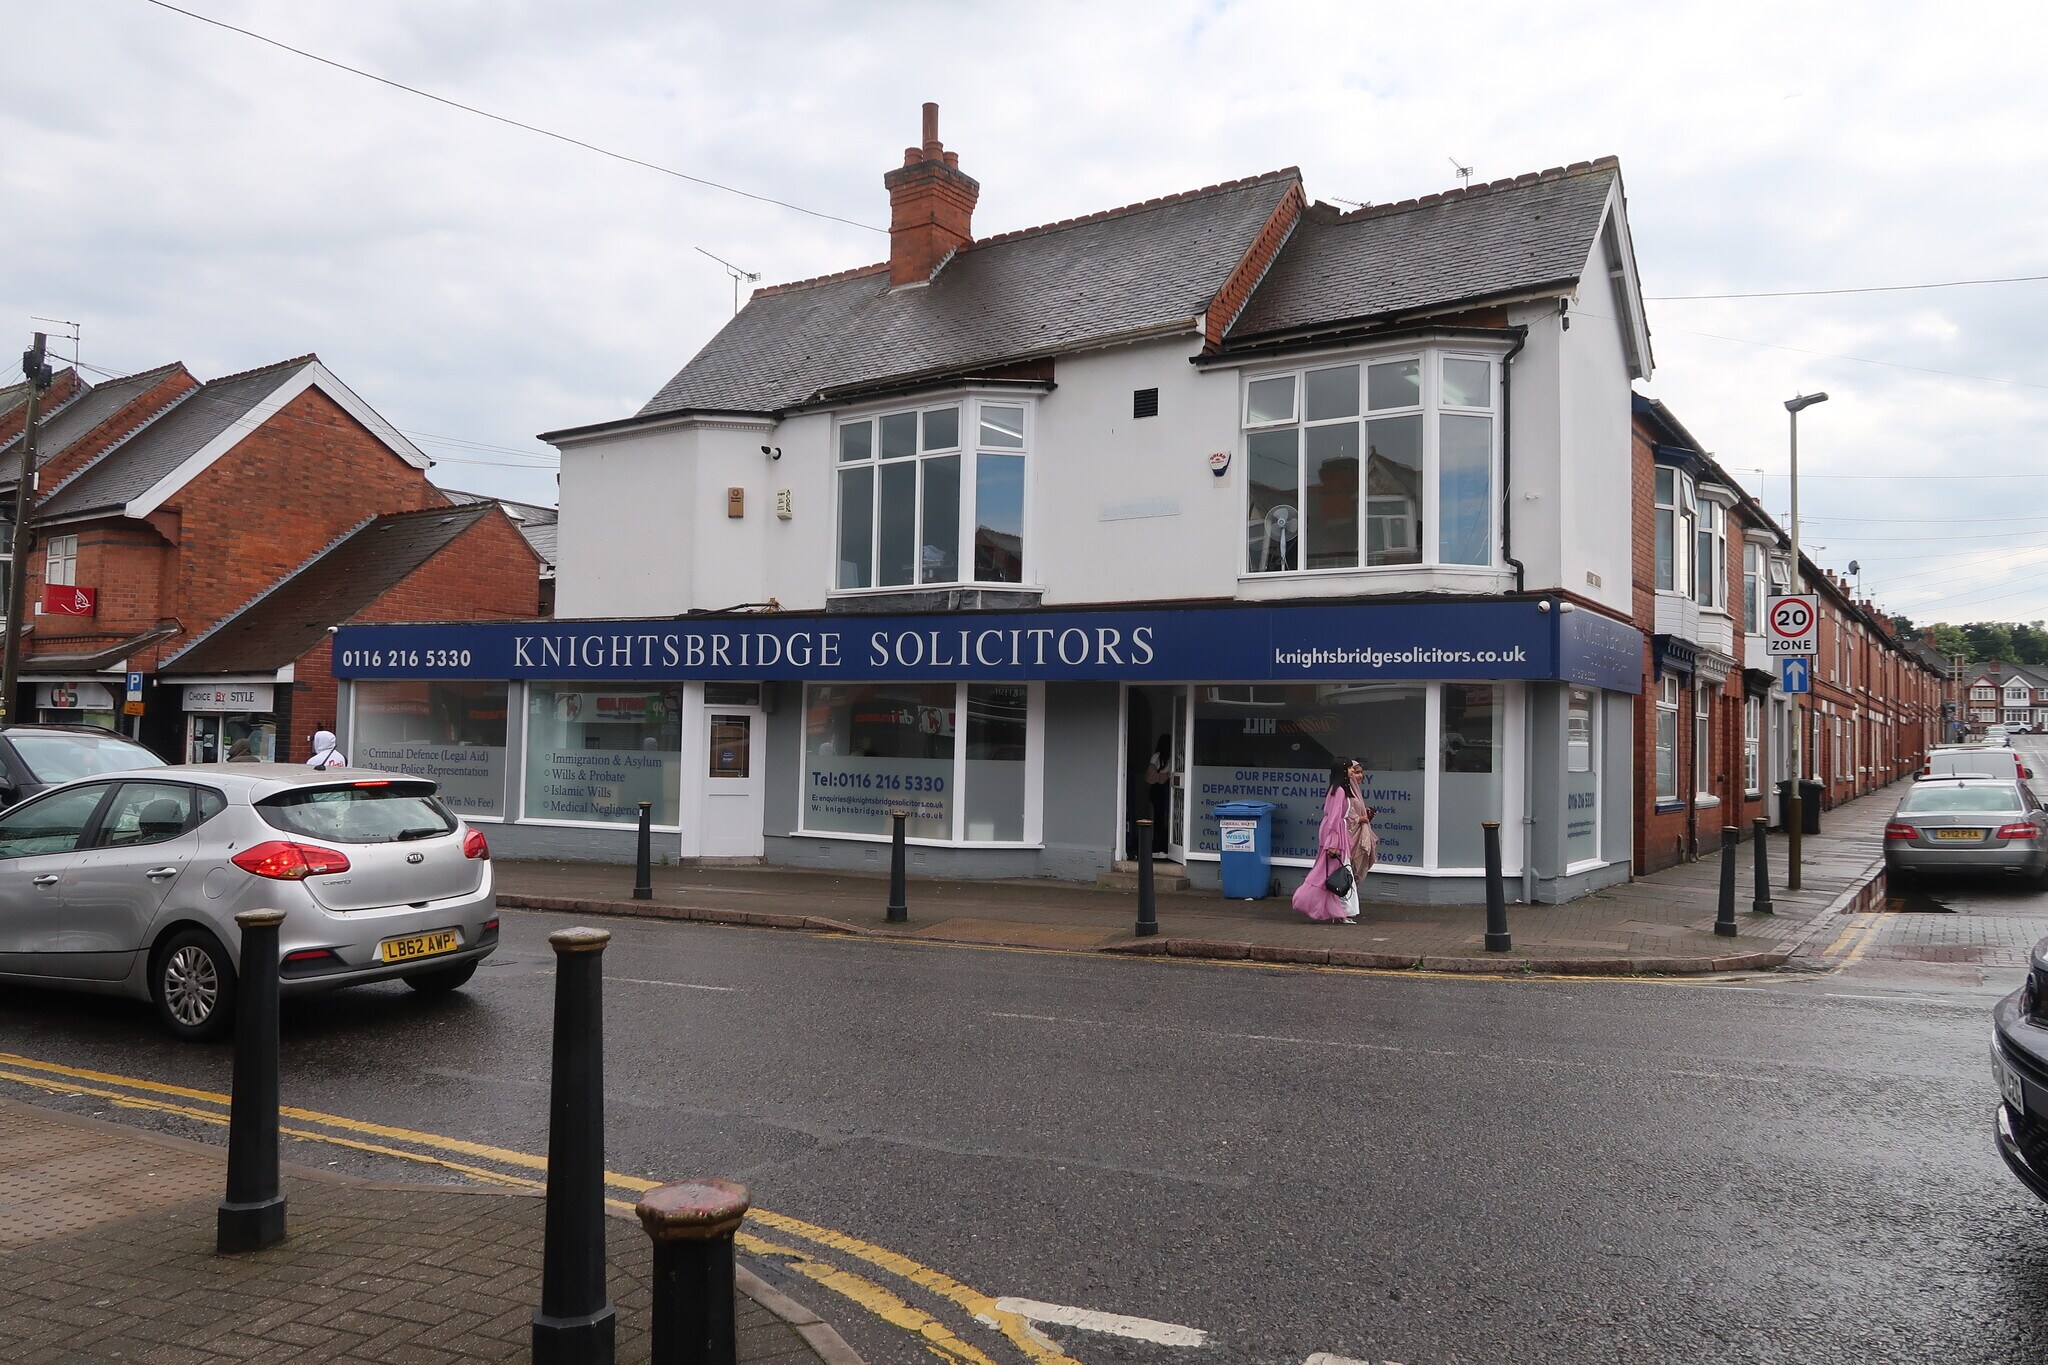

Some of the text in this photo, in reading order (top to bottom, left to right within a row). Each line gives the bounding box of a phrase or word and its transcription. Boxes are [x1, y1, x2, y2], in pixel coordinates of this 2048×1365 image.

[1777, 609, 1807, 626] 20
[514, 626, 1154, 668] KNIGHTSBRIDGE SOLICITORS
[1772, 640, 1811, 650] ZONE
[342, 650, 471, 667] 0116 216 5330
[1275, 645, 1527, 669] knightsbridgesolicitors.co.uk
[130, 674, 140, 690] P
[230, 691, 255, 702] STYLE
[368, 748, 489, 762] Criminal Defence (Legal Aid)
[552, 753, 662, 769] Immigration & Asylum
[400, 763, 425, 774] Police
[427, 764, 489, 778] Representation
[552, 769, 626, 782] Wills & Probate
[1235, 771, 1326, 783] OUR PERSONAL
[812, 771, 945, 792] Tel:0116 216 5330
[551, 785, 611, 798] Islamic Wills
[1202, 784, 1279, 796] DEPARTMENT
[1281, 787, 1307, 797] CAN
[1373, 789, 1411, 801] WITH:
[446, 796, 494, 809] Win No Fee)
[550, 800, 587, 814] Medical
[1385, 822, 1413, 831] Claims
[1380, 838, 1400, 846] Falls
[408, 854, 422, 863] KIA
[1199, 841, 1220, 851] CALL
[1396, 853, 1413, 863] 967
[388, 933, 450, 959] LB62 AWP
